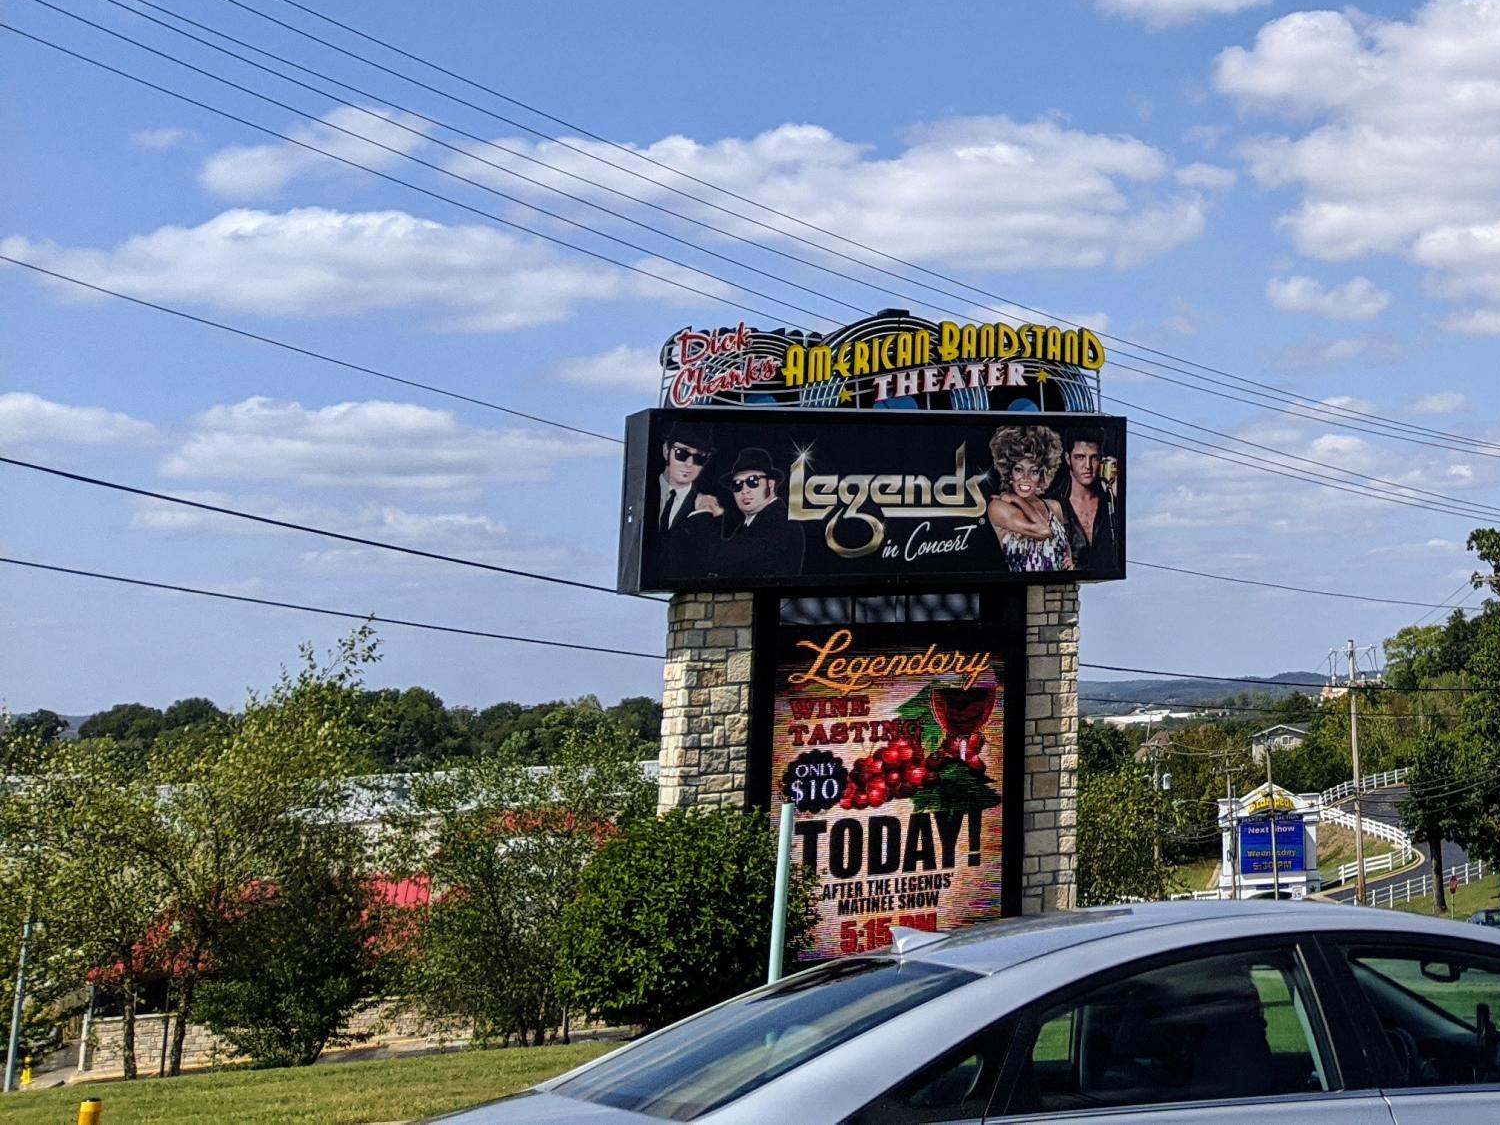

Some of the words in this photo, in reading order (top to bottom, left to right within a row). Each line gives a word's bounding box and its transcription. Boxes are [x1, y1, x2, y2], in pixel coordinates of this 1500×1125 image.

[674, 321, 752, 365] Dick
[782, 329, 930, 387] AMERICAN
[938, 321, 1106, 371] BANDSTAND
[670, 355, 783, 408] Clark's
[872, 362, 1028, 402] THEATER
[788, 440, 987, 558] Legends
[882, 539, 899, 559] in
[904, 521, 977, 561] Concert
[788, 629, 991, 694] Legendary
[788, 694, 871, 720] WINE
[788, 719, 922, 746] TASTING
[795, 763, 836, 777] ONLY
[790, 779, 838, 804] $10
[795, 809, 982, 879] TODAY!
[1248, 826, 1270, 834] Next
[1273, 825, 1295, 833] how
[1247, 849, 1297, 857] Wednsday
[823, 881, 863, 900] AFTER
[867, 878, 890, 896] THE
[837, 895, 894, 915] MATINEE
[898, 891, 939, 908] SHOW
[840, 917, 893, 953] 5:15
